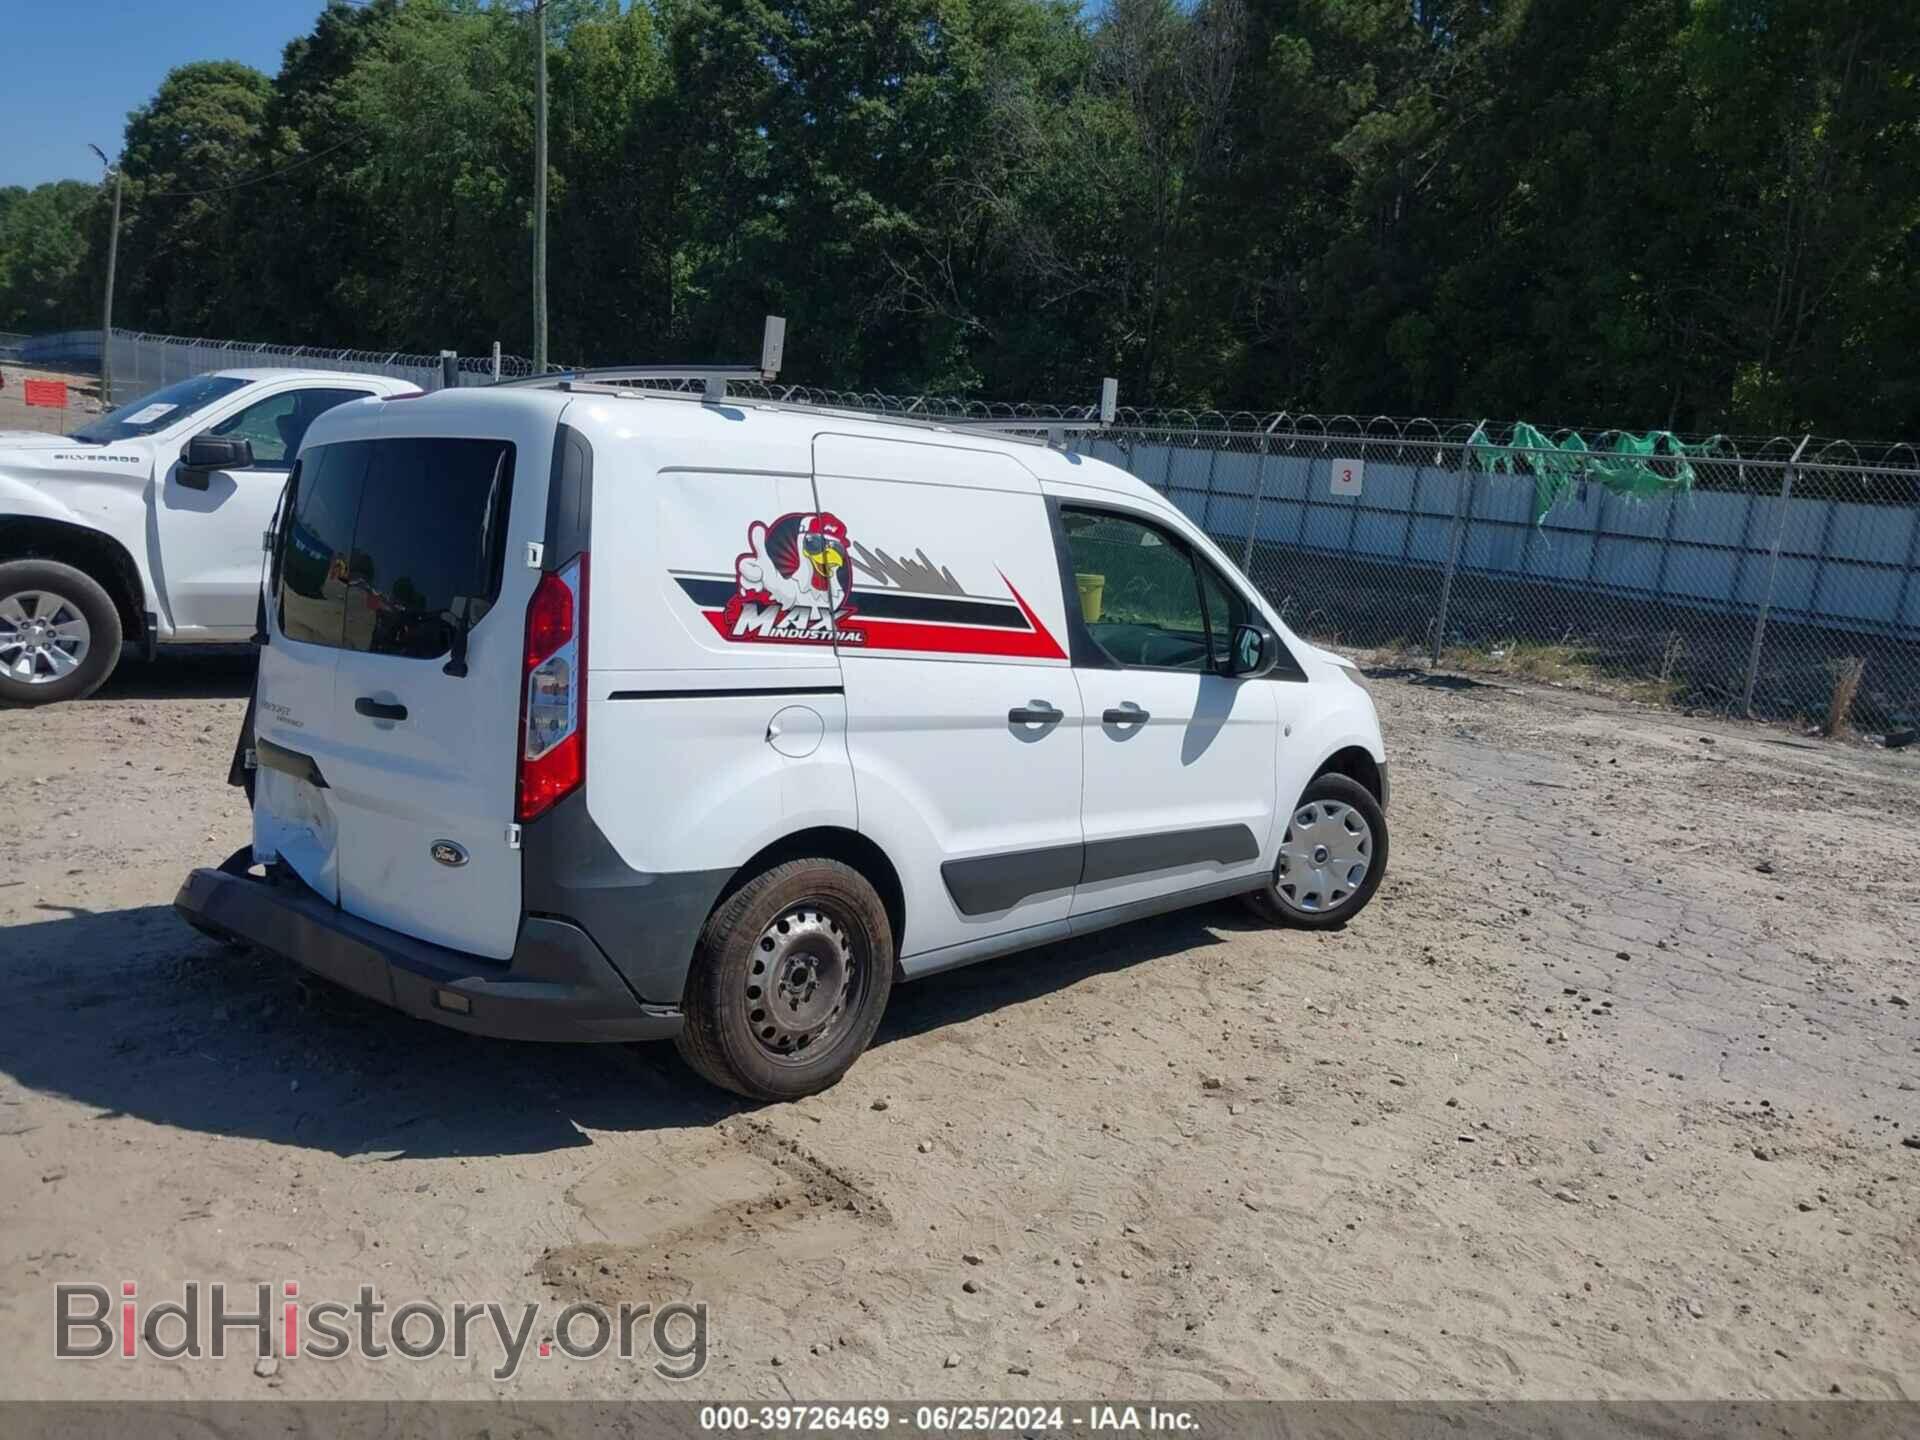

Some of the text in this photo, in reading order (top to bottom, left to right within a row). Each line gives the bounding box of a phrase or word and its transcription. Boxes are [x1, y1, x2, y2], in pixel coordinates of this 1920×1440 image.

[1343, 470, 1352, 482] 3
[732, 602, 850, 637] MAX
[769, 627, 864, 642] INDUSTRIAL
